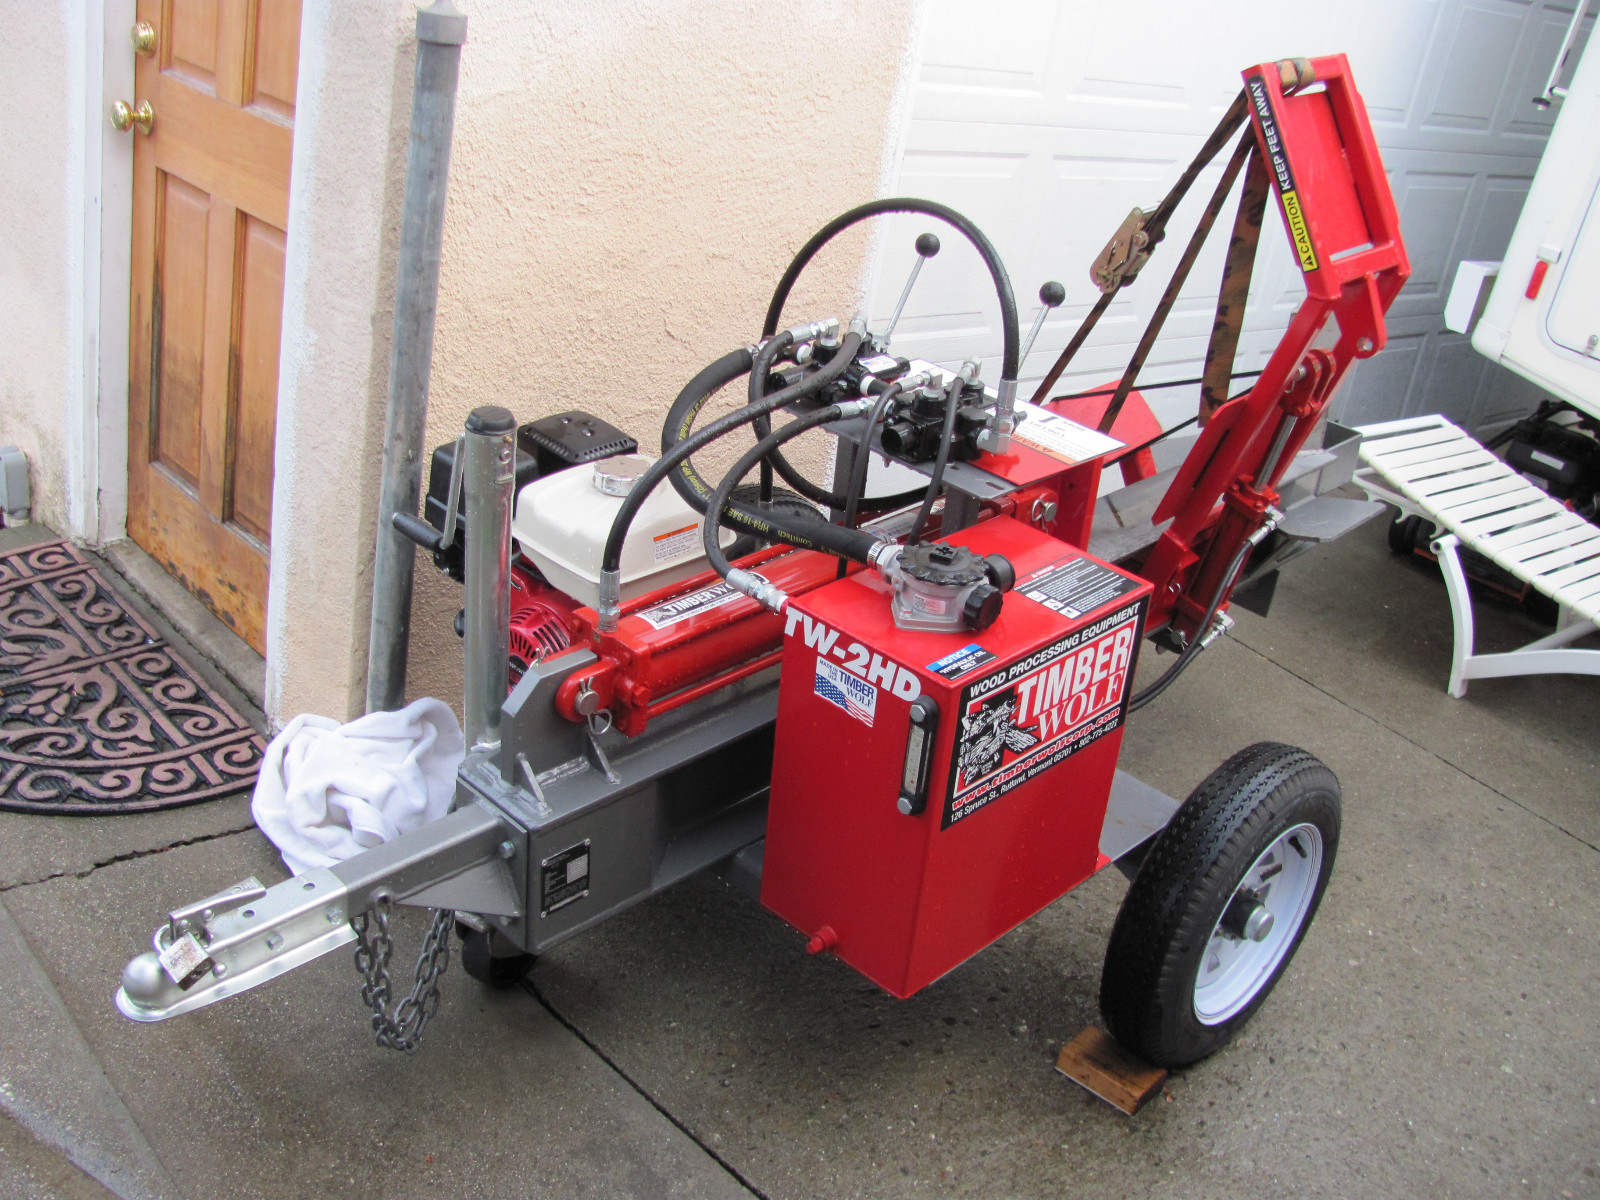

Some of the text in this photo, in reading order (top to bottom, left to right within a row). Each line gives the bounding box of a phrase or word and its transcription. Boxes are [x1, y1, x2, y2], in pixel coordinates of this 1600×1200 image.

[1250, 83, 1310, 254] CAUTION KEEP FEET AWAY
[728, 507, 744, 522] SAE
[743, 515, 770, 533] HR4-16
[667, 590, 716, 615] TIMBER
[784, 605, 922, 702] TW-2HD
[819, 659, 832, 670] MADE
[937, 648, 971, 666] NOTICE
[960, 660, 977, 670] ONLY
[970, 670, 1006, 698] WOOD
[1009, 633, 1080, 679] PROCESSING
[1081, 602, 1142, 642] EQUIPMENT
[839, 670, 875, 700] TIMBER
[1017, 627, 1132, 725] TIMBER
[846, 687, 873, 708] WOLF
[1038, 671, 1124, 742] WOLF
[951, 707, 1121, 812] www.timberwolfcorp.com
[950, 809, 963, 823] 126
[963, 798, 988, 817] Spruce
[1000, 775, 1027, 795] Rutland,
[1028, 758, 1053, 778] Vermont
[1053, 747, 1072, 763] 05701
